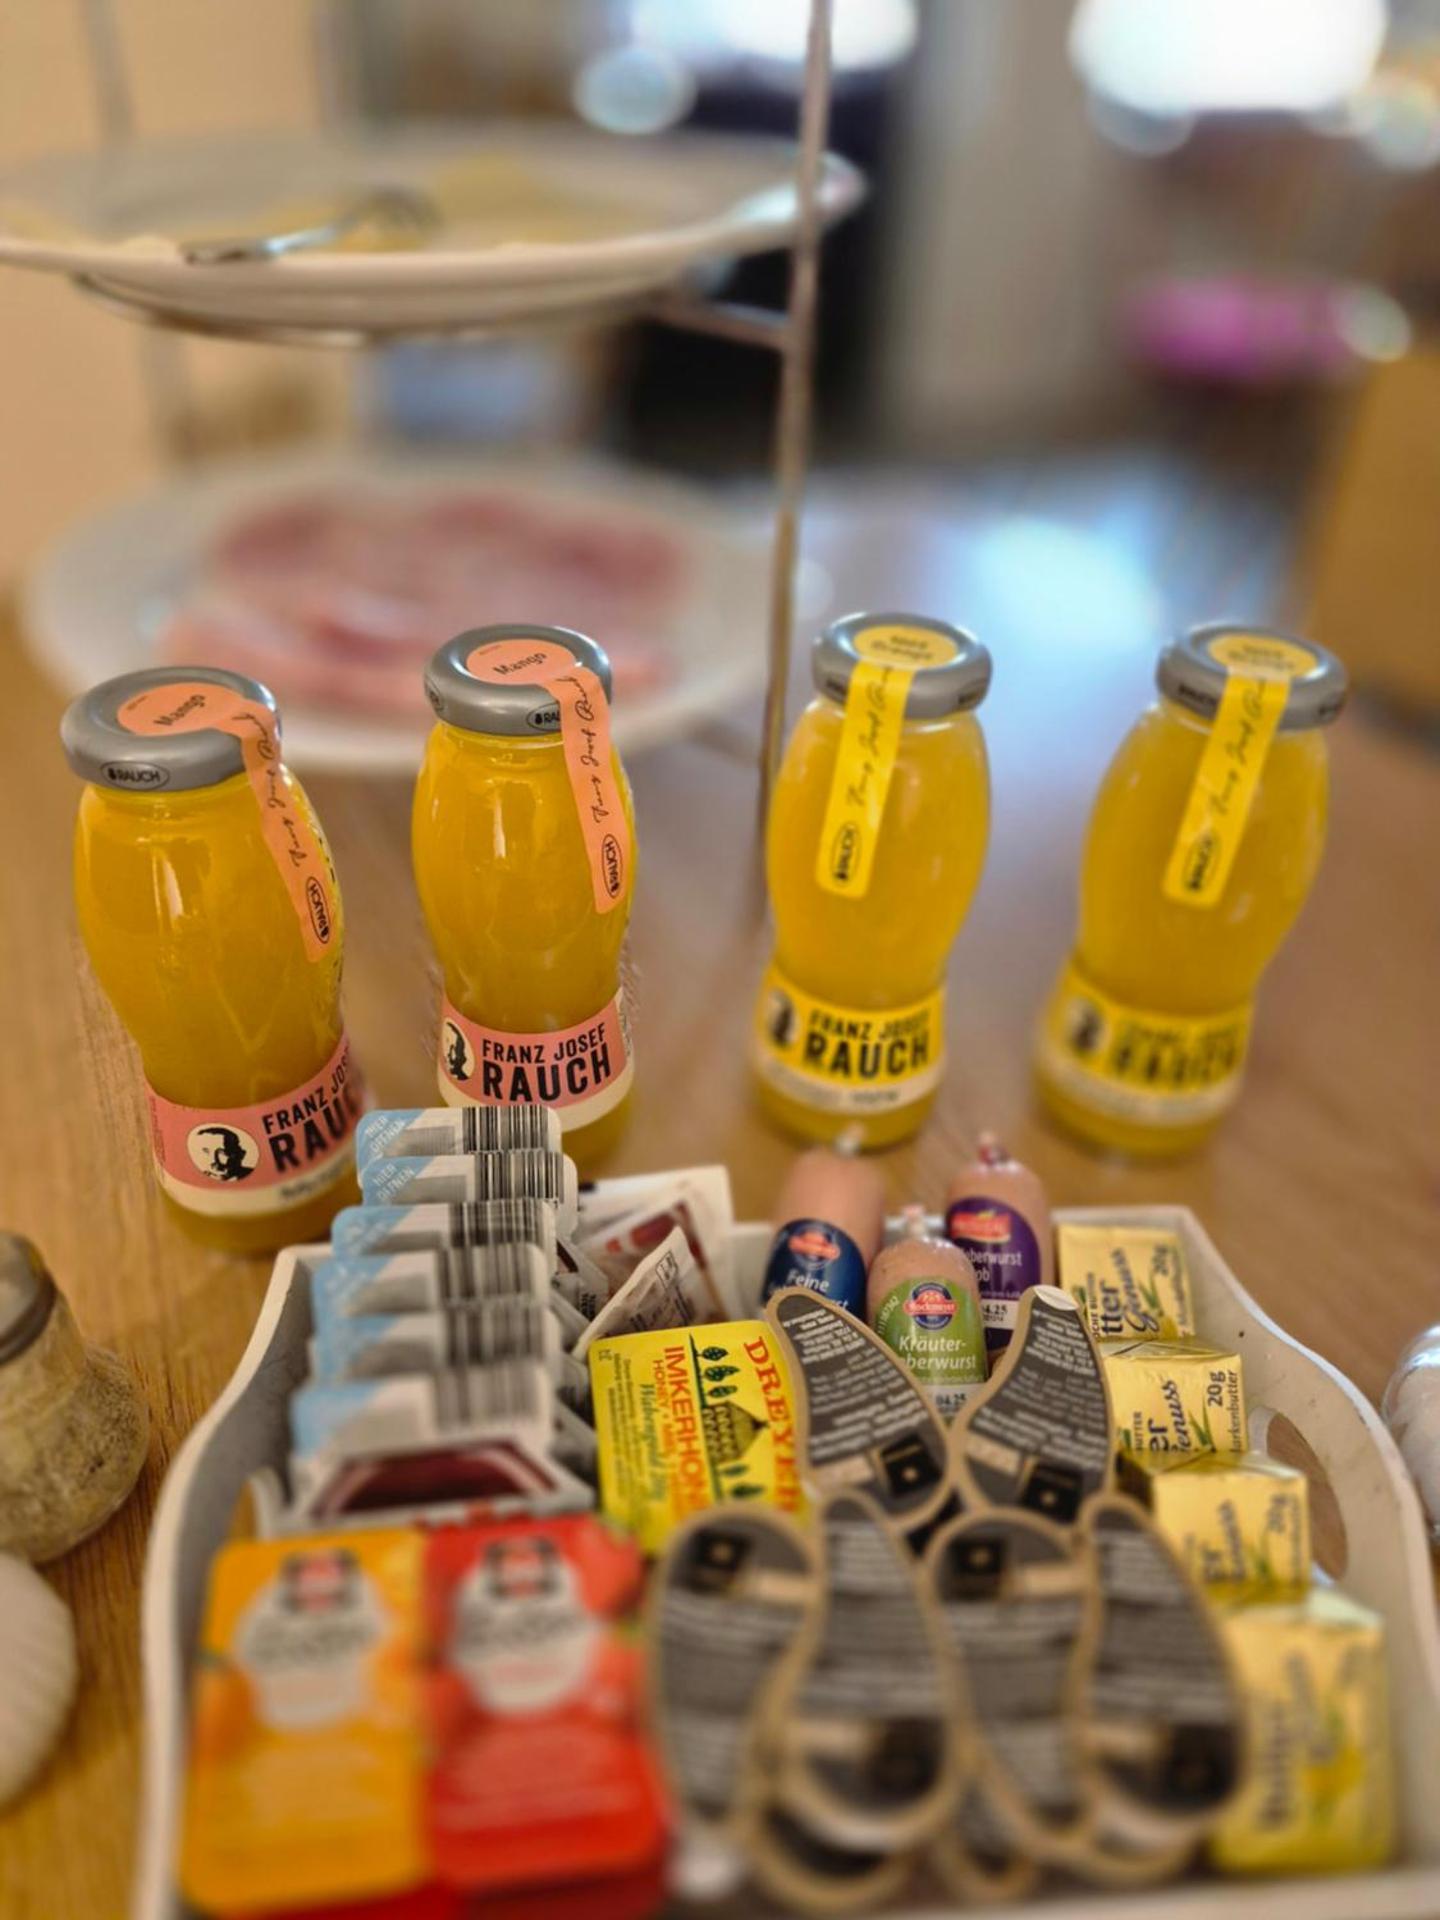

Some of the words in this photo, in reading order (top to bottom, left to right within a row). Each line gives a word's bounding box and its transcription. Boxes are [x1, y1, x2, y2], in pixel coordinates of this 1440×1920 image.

[493, 651, 547, 676] Mango
[154, 694, 206, 727] Mango
[116, 769, 161, 783] RAUCH
[810, 1009, 873, 1041] FRANZ
[482, 1038, 545, 1064] FRANZ
[554, 1022, 606, 1061] JOSEF
[803, 1029, 930, 1080] RAUCH
[482, 1042, 612, 1102] RAUCH
[262, 1085, 329, 1135] FRANZ
[966, 1247, 1023, 1266] berwurst
[787, 1268, 830, 1292] Feine
[1100, 1278, 1125, 1336] tter
[899, 1334, 967, 1352] Kräuter-
[904, 1351, 977, 1370] berwurst
[1207, 1371, 1227, 1407] 20g
